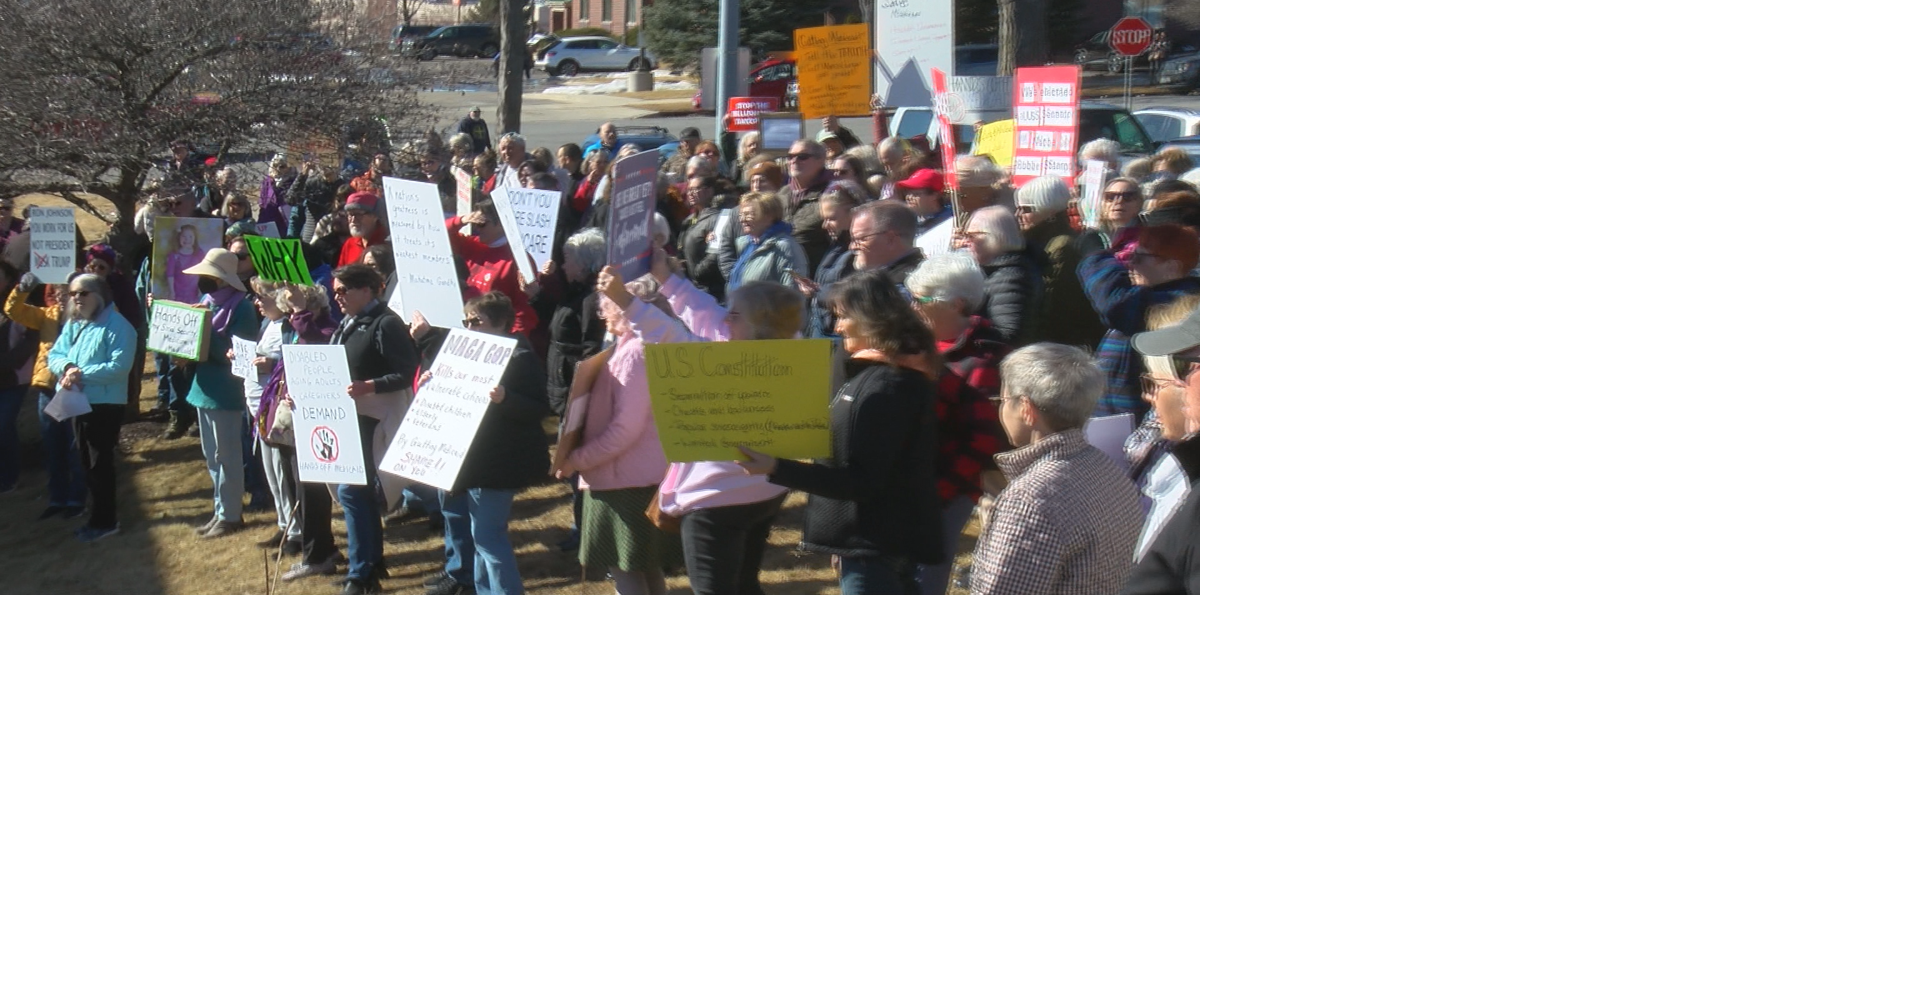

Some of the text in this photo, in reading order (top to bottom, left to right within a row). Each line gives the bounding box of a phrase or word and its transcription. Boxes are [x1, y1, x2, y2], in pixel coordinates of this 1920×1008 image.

[1112, 29, 1150, 44] STOP
[532, 192, 553, 208] YOU
[46, 209, 74, 218] JOHNSON
[526, 212, 552, 228] SLASH
[32, 222, 74, 232] YOU WORK FOR US
[416, 218, 426, 236] by
[428, 222, 440, 232] how
[32, 240, 74, 250] NOT PRESIDENT
[51, 256, 71, 268] TRUMP
[246, 239, 306, 283] WHY
[154, 305, 198, 327] Hands Off
[443, 334, 486, 362] MAGA
[289, 351, 327, 364] DISABLED
[699, 346, 792, 378] Constitution
[434, 362, 454, 379] Kills
[472, 373, 496, 384] most
[290, 378, 342, 386] AGING ADULTS
[300, 392, 341, 401] CAREGIVERS
[302, 407, 346, 420] DEMAND
[444, 404, 472, 419] children
[396, 432, 408, 447] By
[300, 462, 364, 474] HANDS OFF MEDICAID
[393, 463, 427, 476] ON YOU
